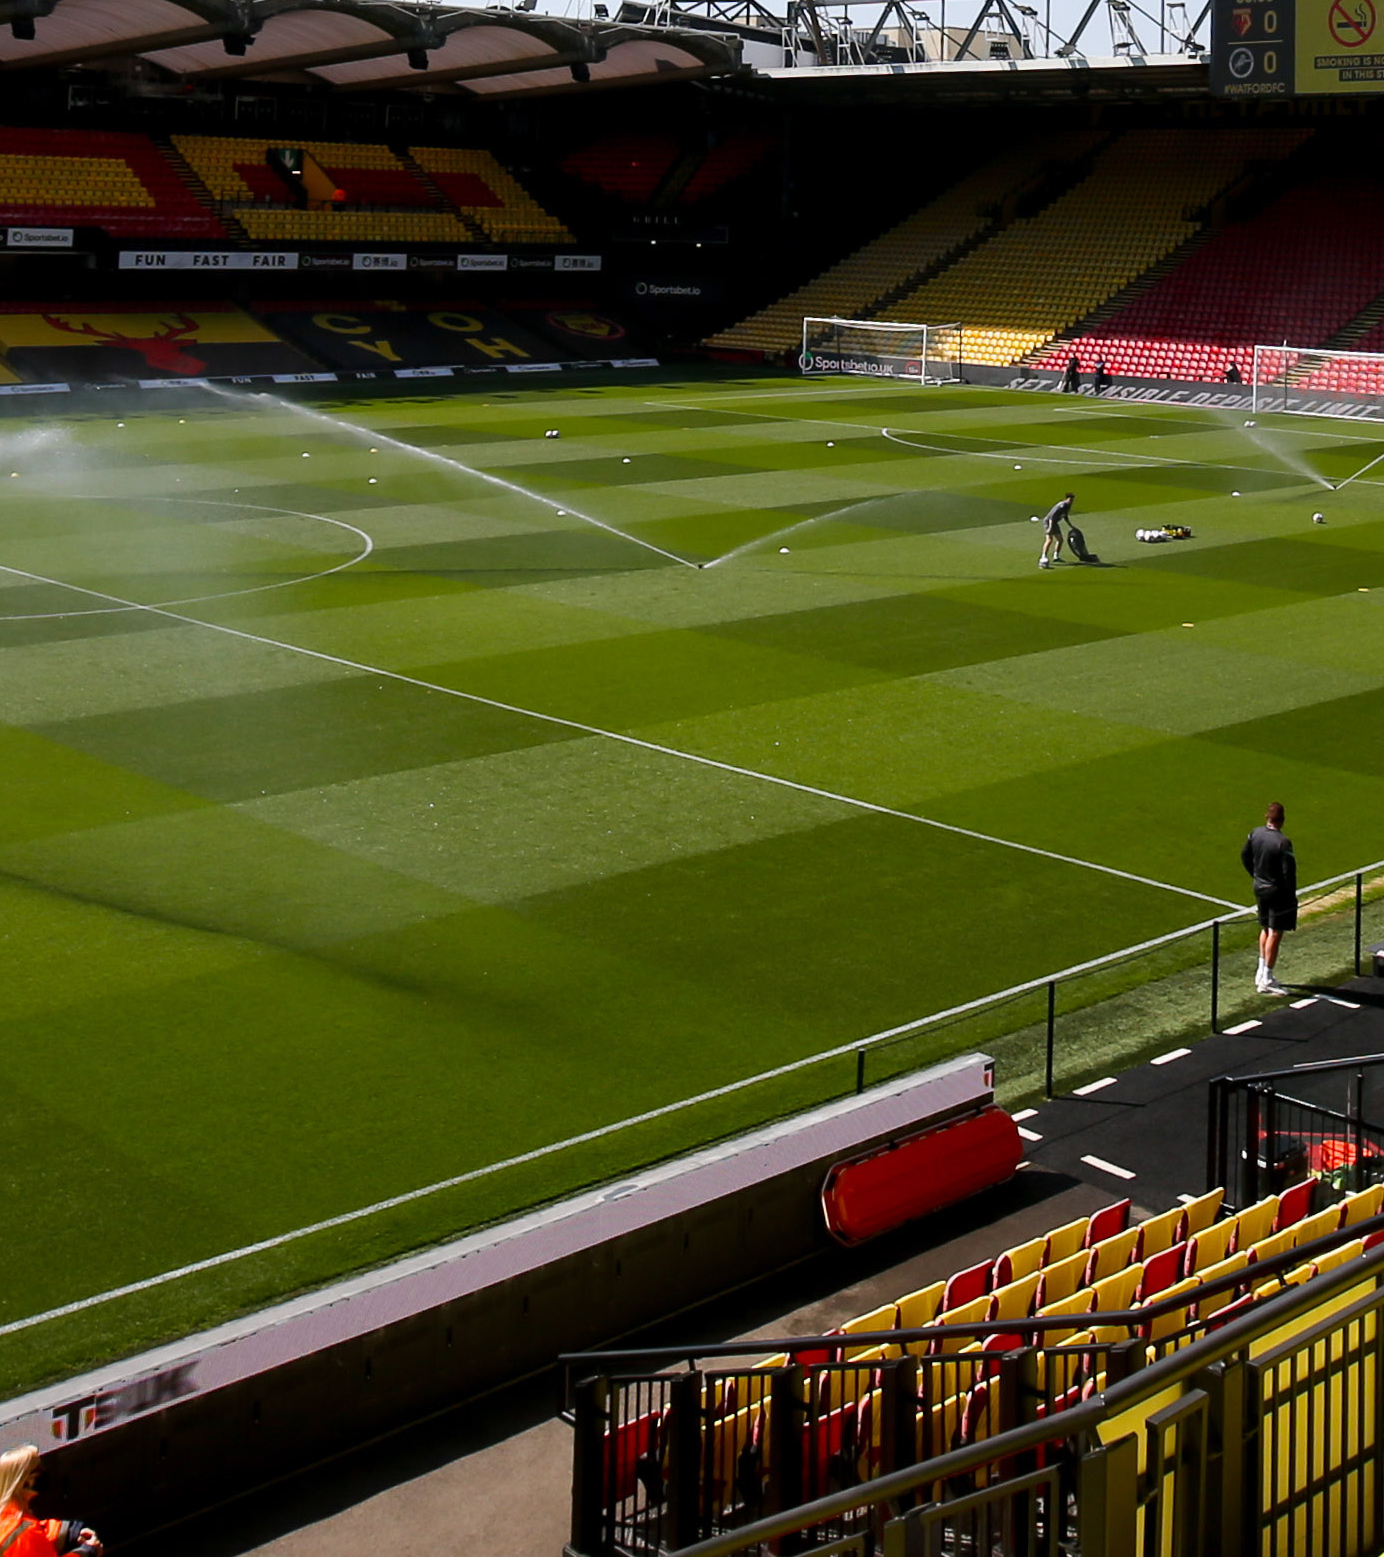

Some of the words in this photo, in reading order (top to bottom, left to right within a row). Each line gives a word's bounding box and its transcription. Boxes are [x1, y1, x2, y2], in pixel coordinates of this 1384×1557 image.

[1263, 10, 1277, 34] 0
[1263, 51, 1277, 74] 0
[1316, 56, 1361, 68] SMOKING
[1363, 56, 1373, 66] IS
[1342, 69, 1352, 80] IN
[1354, 69, 1375, 79] THIS
[135, 254, 166, 266] FUN
[193, 254, 229, 266] FAST
[252, 255, 287, 267] FAIR
[1005, 377, 1053, 392] SET
[1187, 392, 1301, 412] DEPOSIT
[1298, 401, 1382, 418] LIMIT
